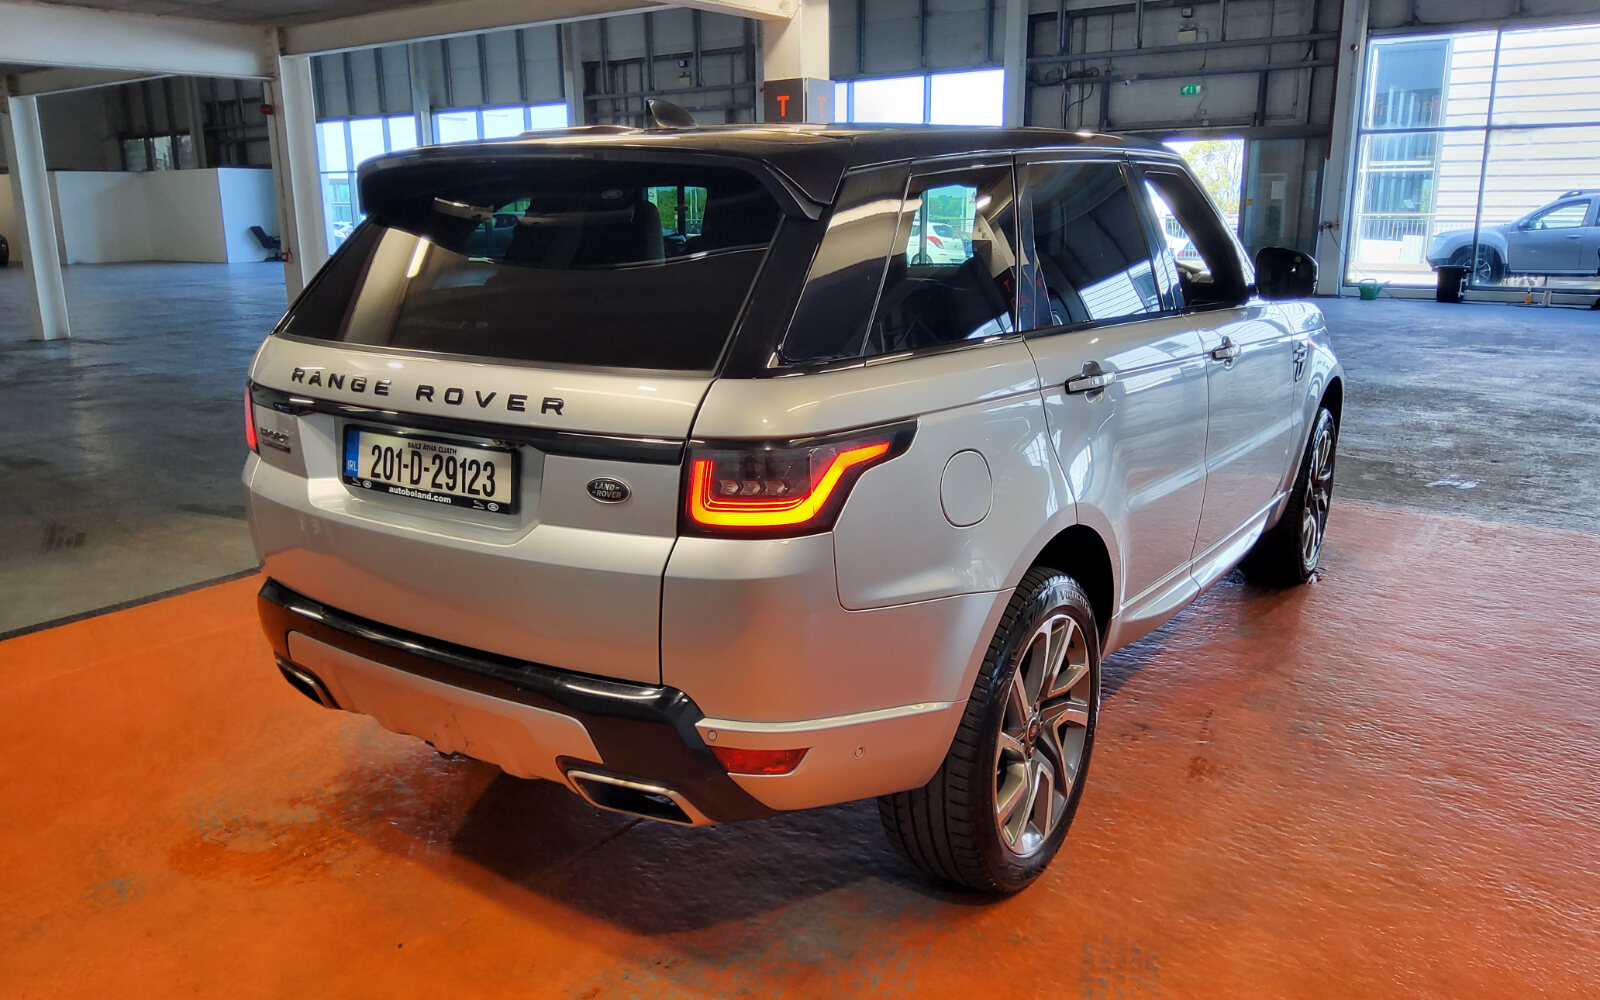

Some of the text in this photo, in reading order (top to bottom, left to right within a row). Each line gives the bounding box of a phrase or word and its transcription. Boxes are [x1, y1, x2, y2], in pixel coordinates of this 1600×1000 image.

[291, 367, 565, 416] RANGE ROVER
[347, 459, 358, 472] IRL
[370, 444, 496, 498] 201-D-29123
[388, 486, 452, 504] autoboland.com
